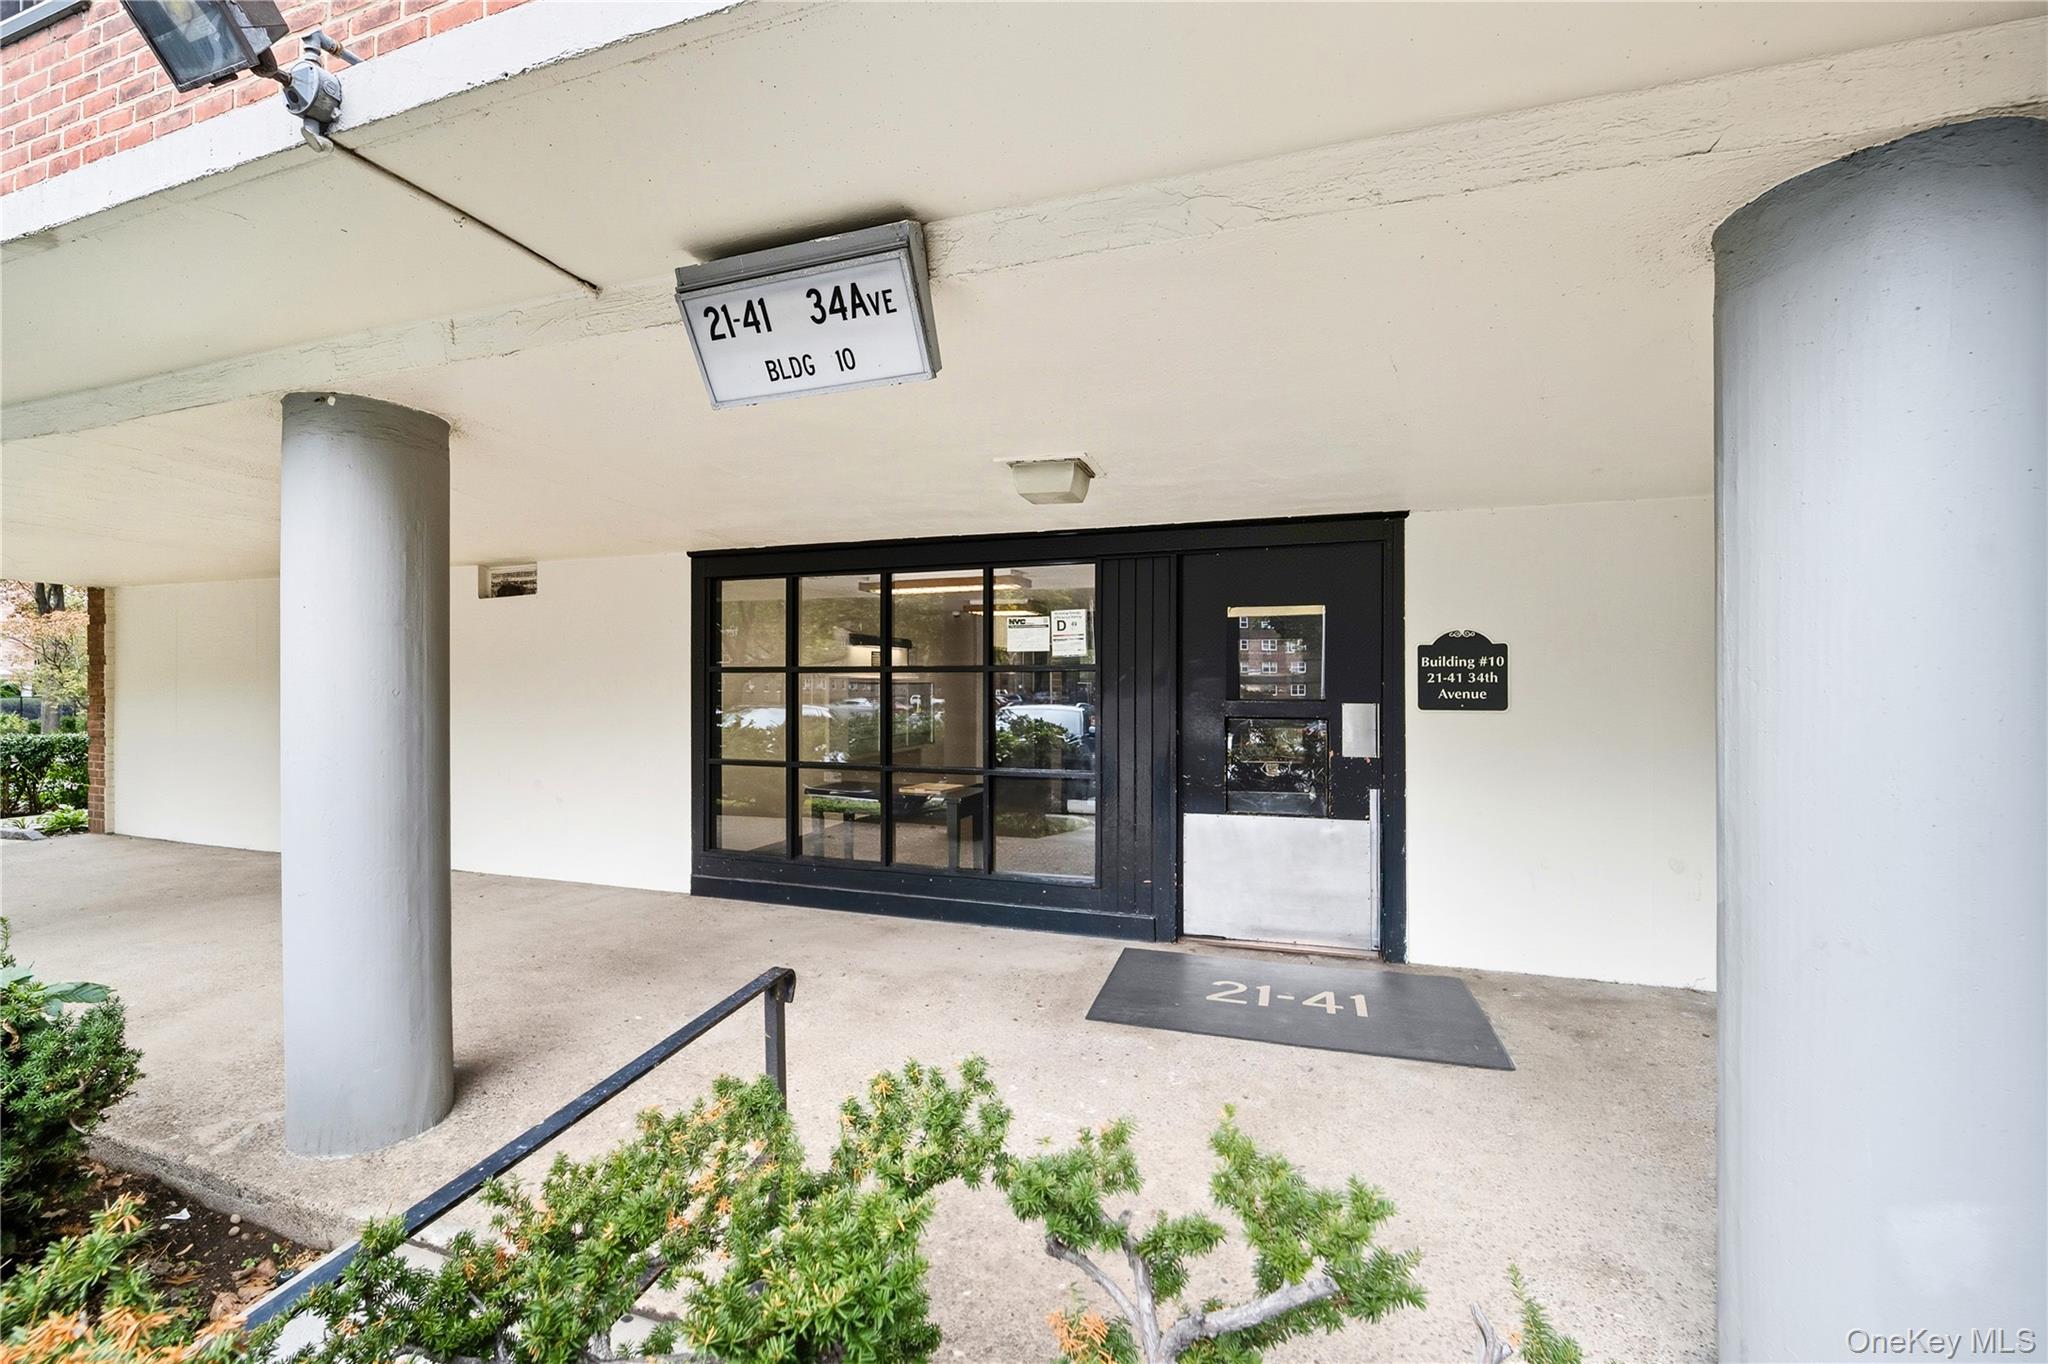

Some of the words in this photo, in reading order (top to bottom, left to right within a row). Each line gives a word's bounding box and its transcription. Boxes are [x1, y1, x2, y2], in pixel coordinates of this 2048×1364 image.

[703, 297, 773, 341] 21-41
[764, 353, 816, 382] BLDG
[834, 347, 856, 372] 10
[1057, 620, 1067, 632] D
[1421, 656, 1476, 670] Building
[1479, 656, 1505, 667] #10
[1427, 672, 1462, 683] 21-41
[1467, 671, 1498, 683] 34th
[1438, 688, 1487, 700] Avenue
[1205, 980, 1369, 1018] 21-41
